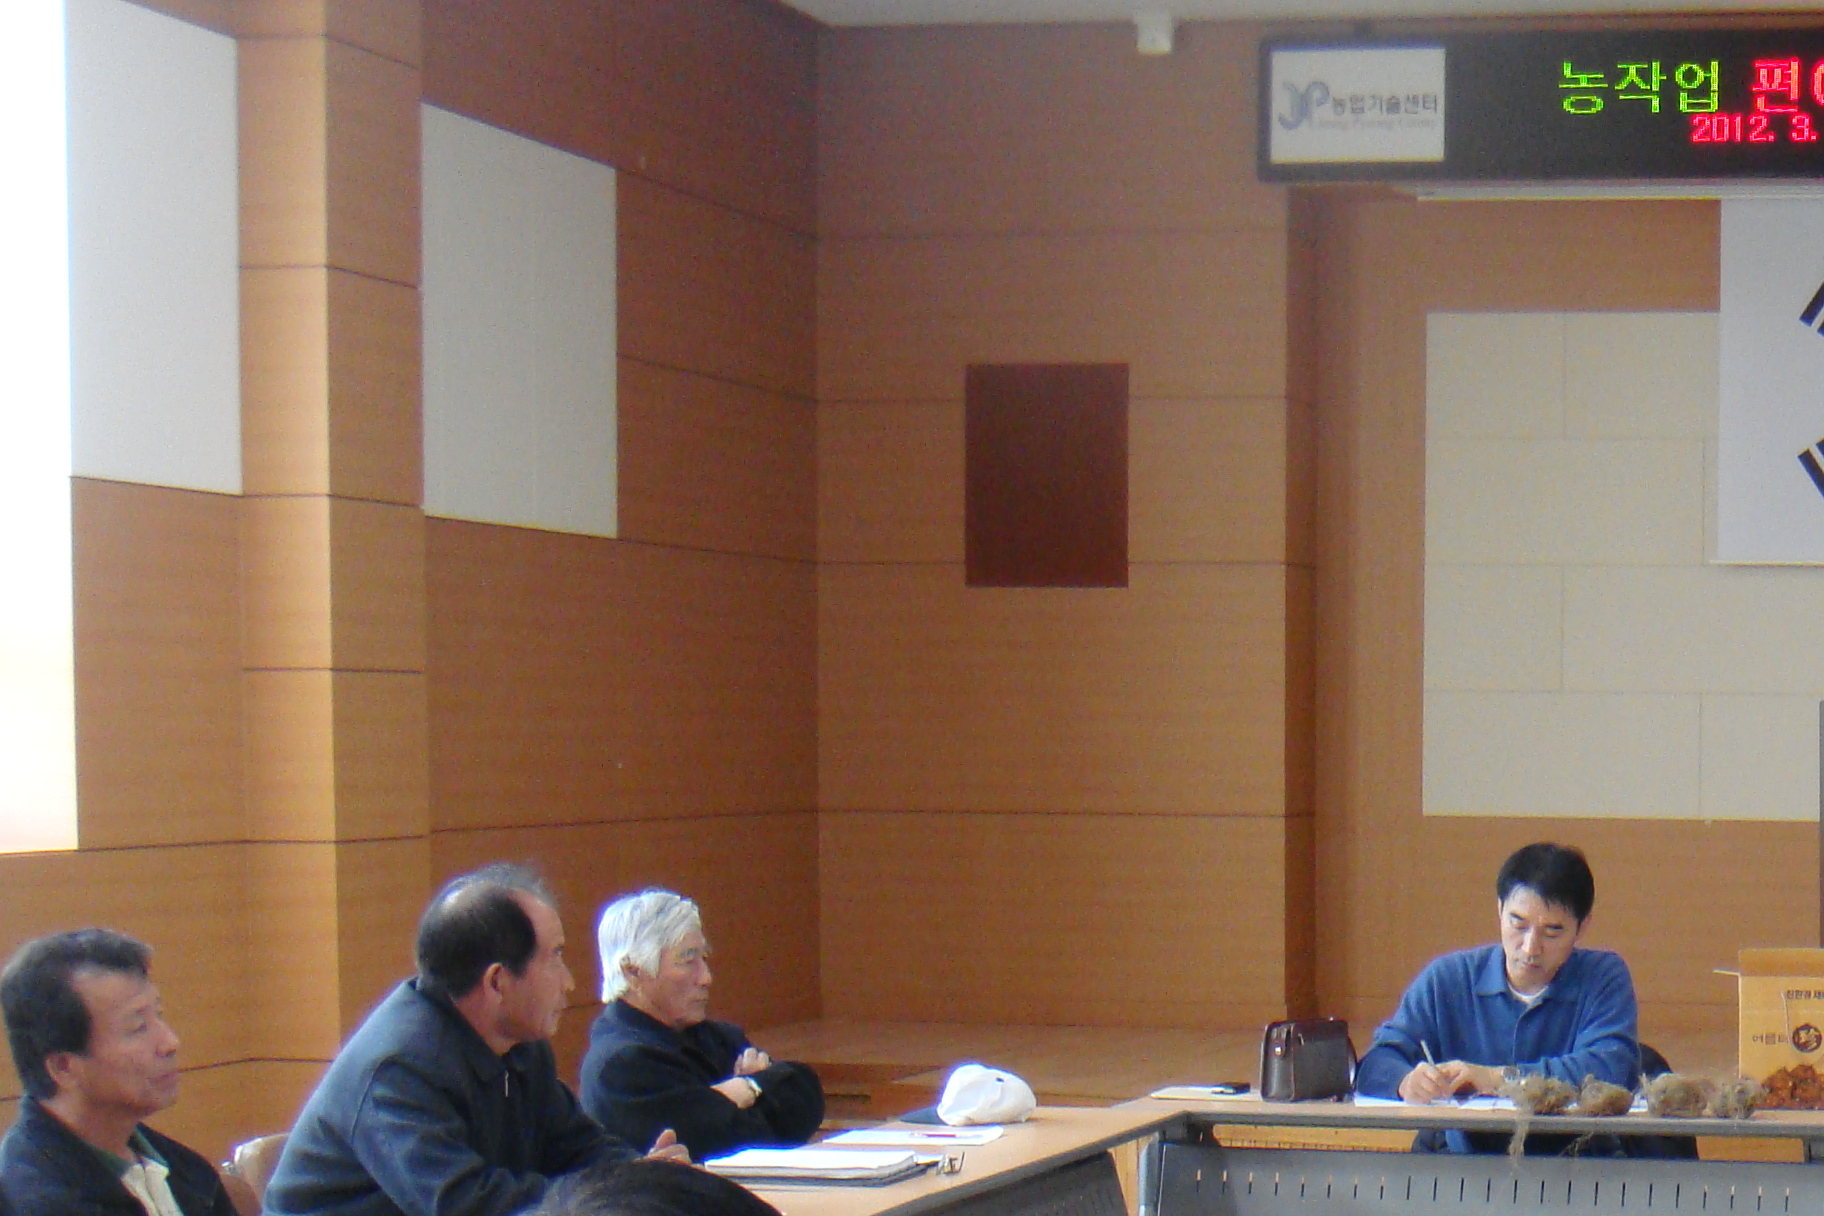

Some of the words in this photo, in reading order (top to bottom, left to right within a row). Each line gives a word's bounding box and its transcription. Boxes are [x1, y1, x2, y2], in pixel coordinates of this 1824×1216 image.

[1559, 59, 1720, 114] 농작업
[1691, 112, 1774, 143] 2012.
[1790, 112, 1819, 143] 3.
